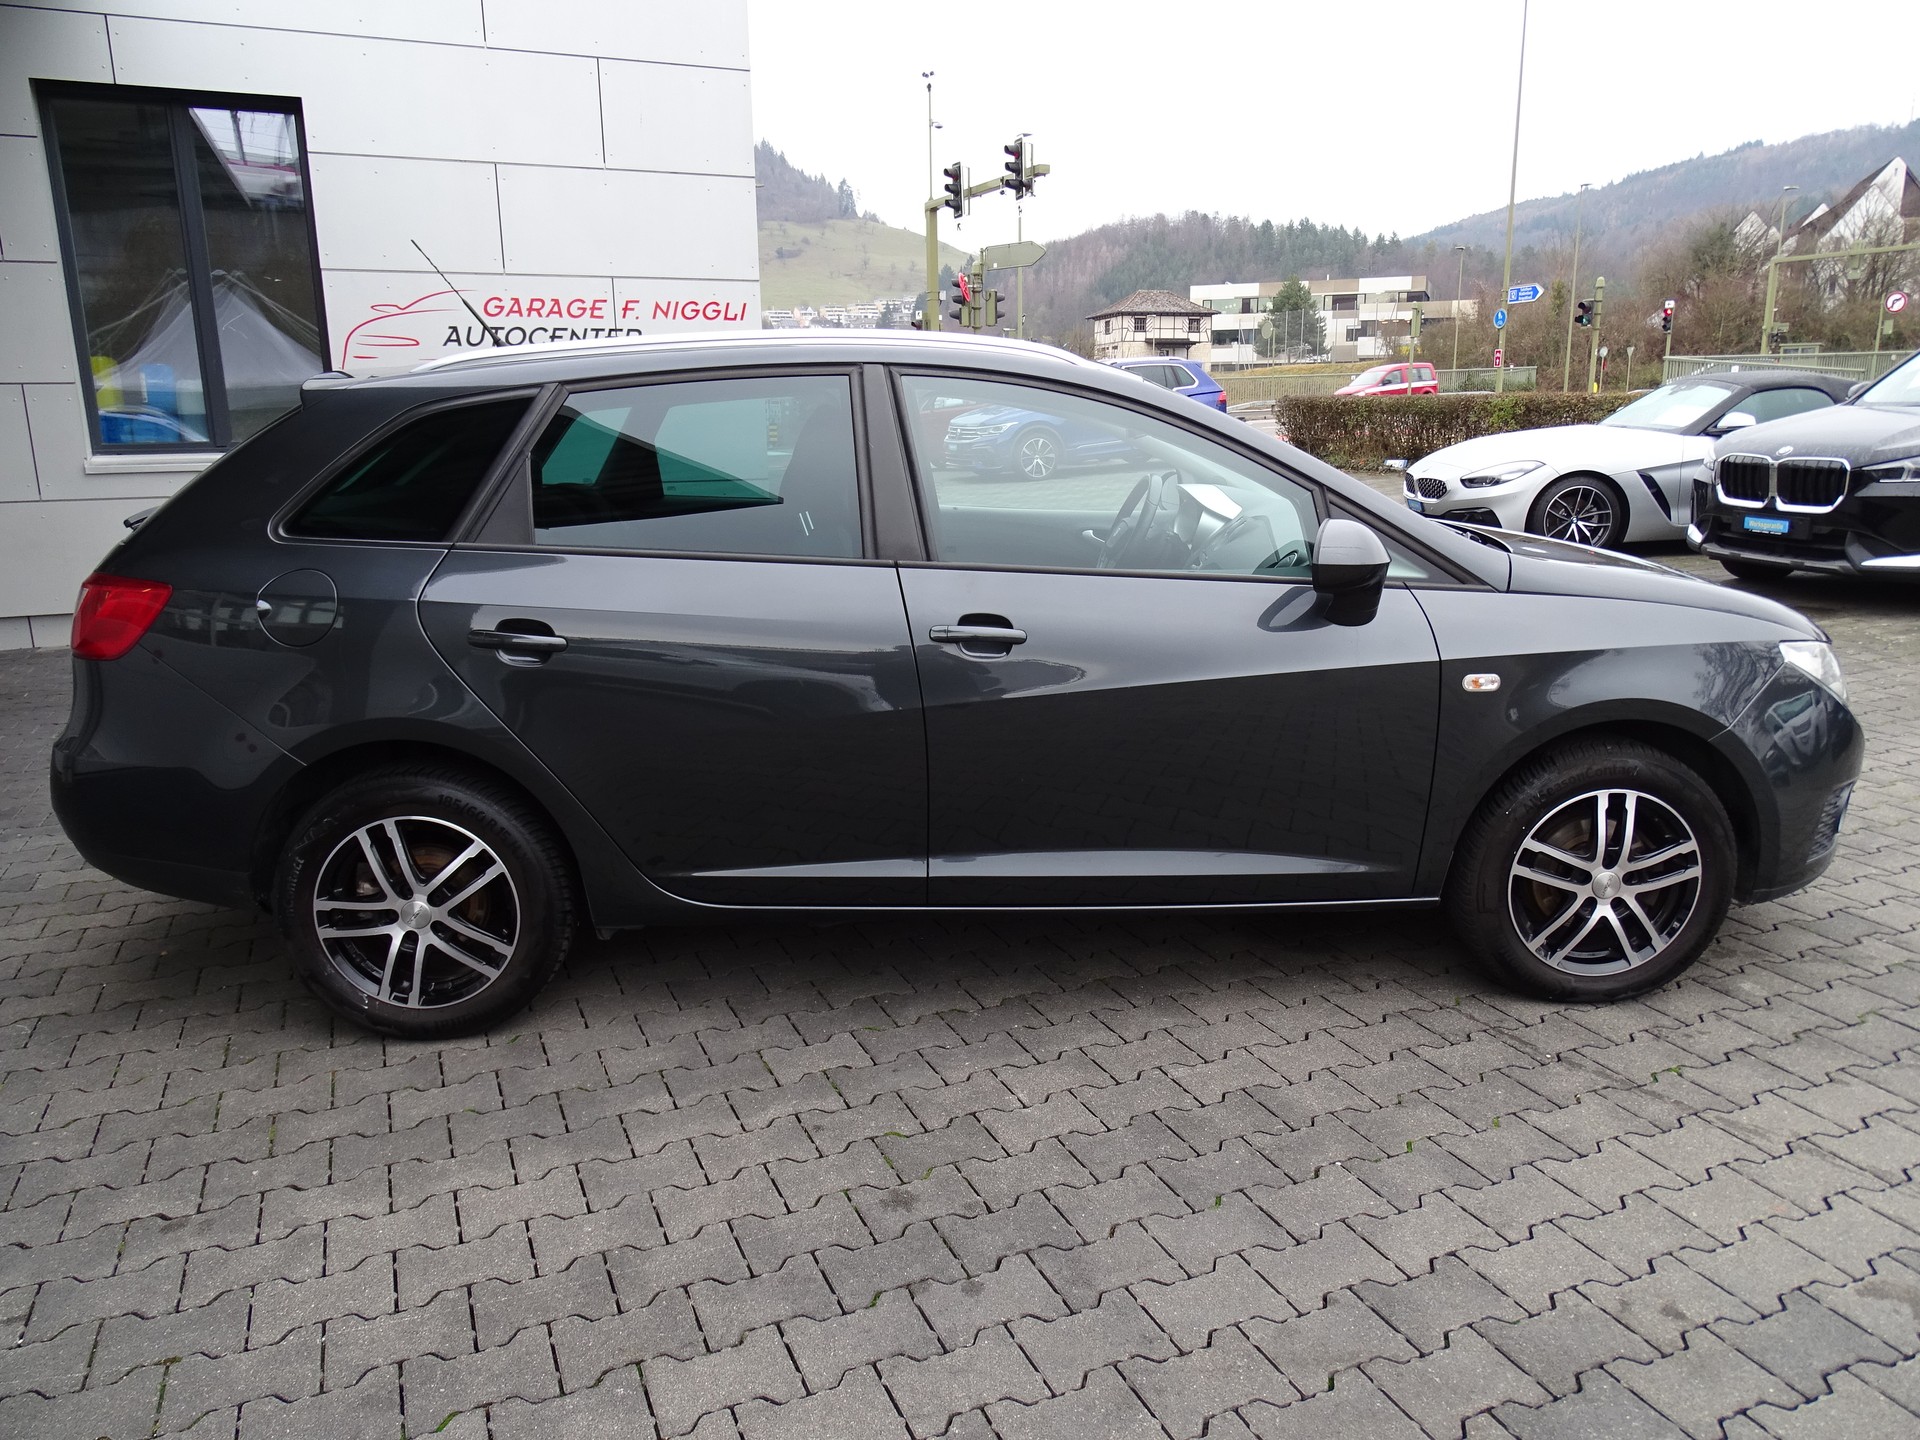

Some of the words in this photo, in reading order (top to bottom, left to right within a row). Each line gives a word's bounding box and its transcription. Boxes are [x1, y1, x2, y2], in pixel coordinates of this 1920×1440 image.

[483, 296, 608, 320] GARAGE
[621, 299, 641, 320] F.
[651, 300, 748, 321] NIGGLI
